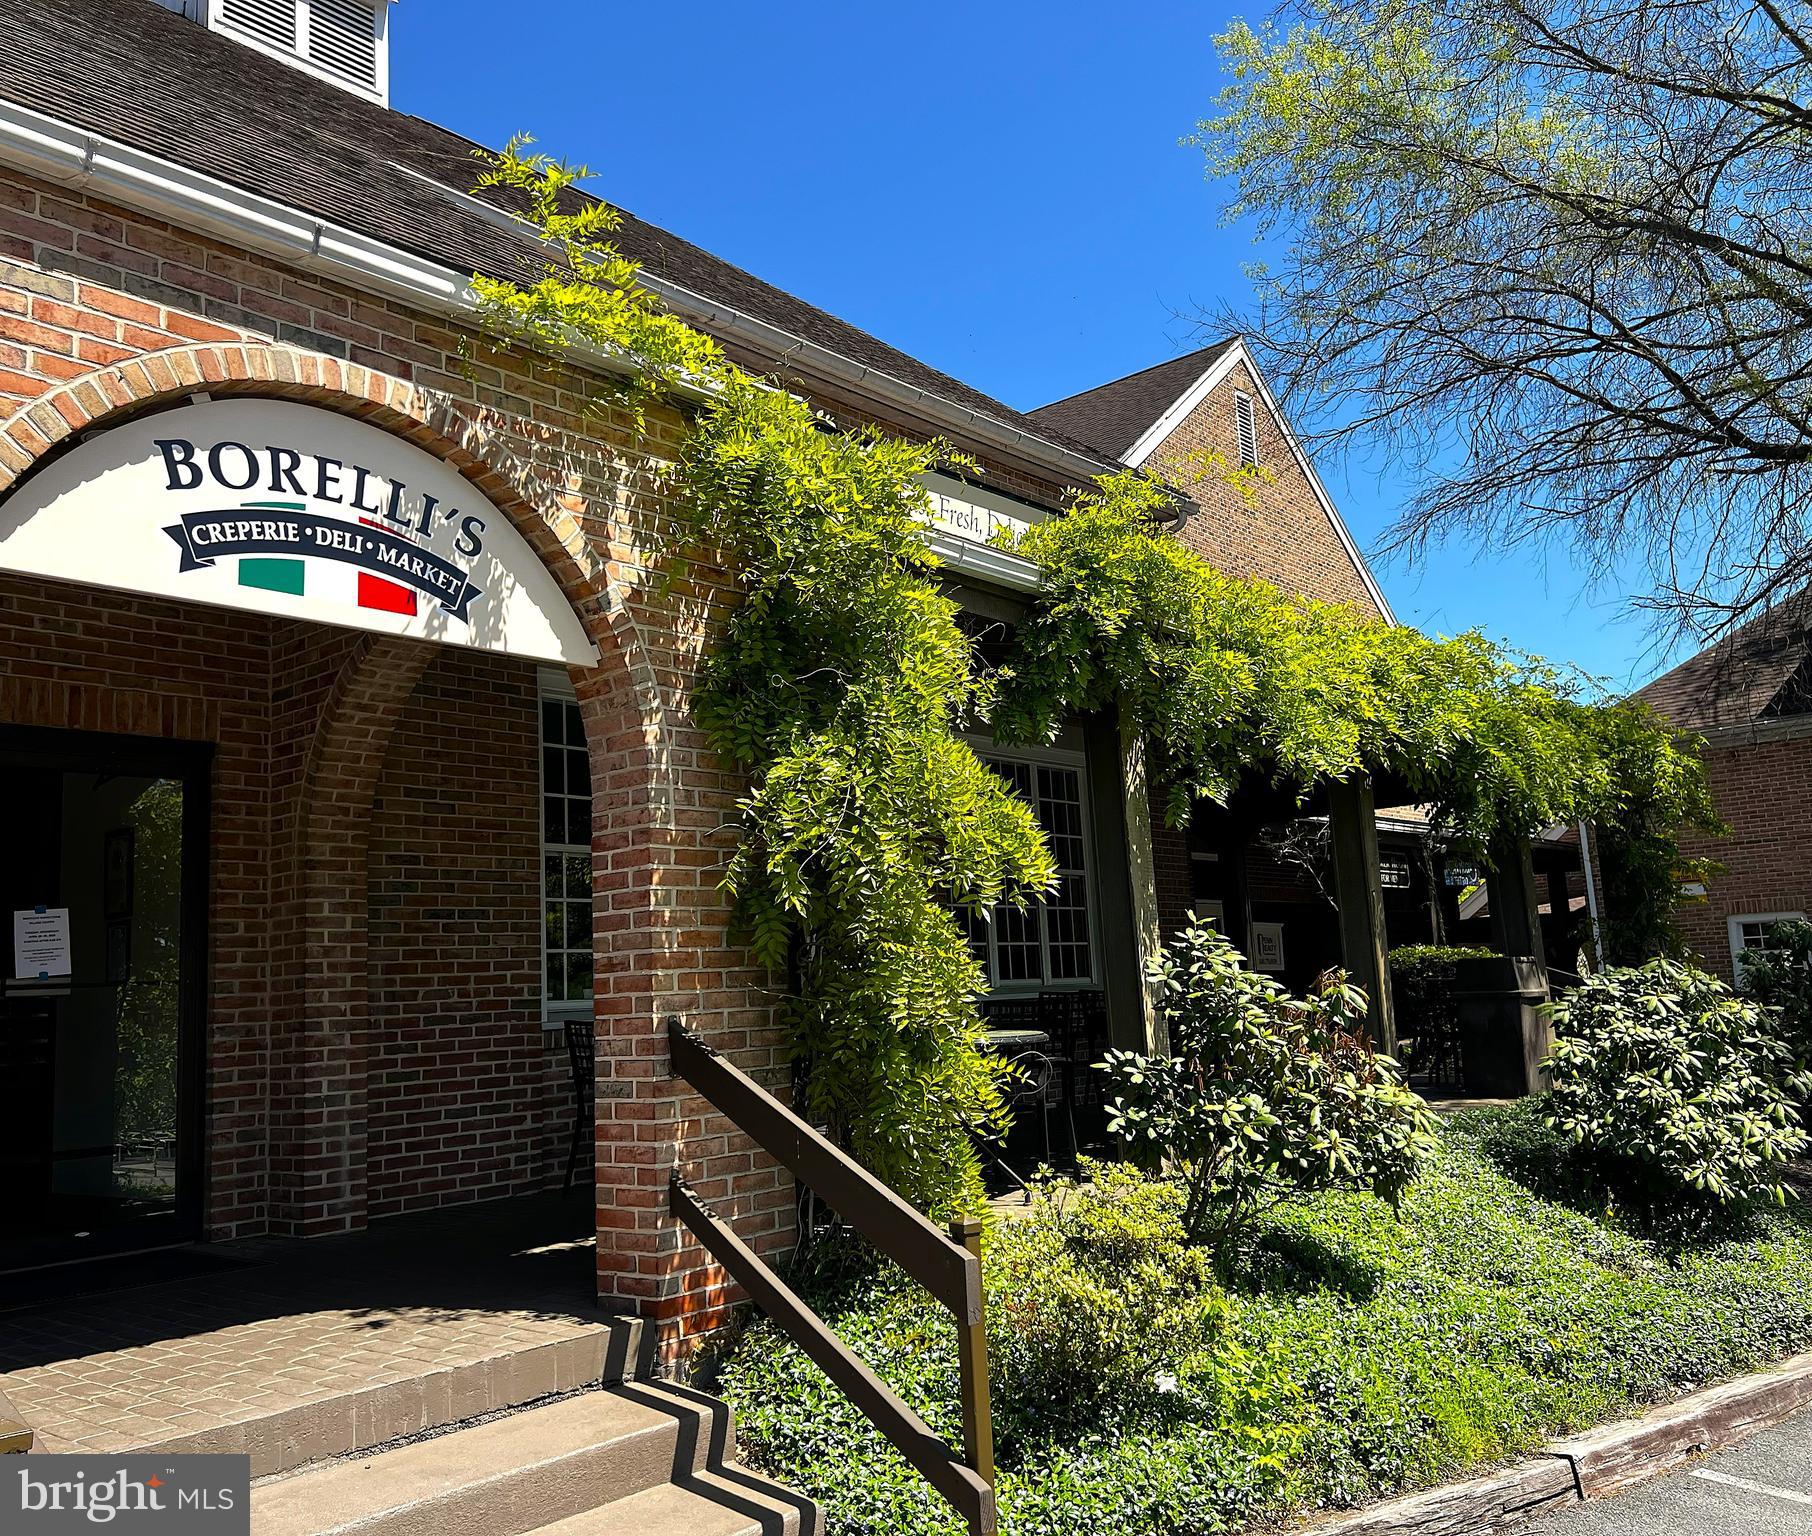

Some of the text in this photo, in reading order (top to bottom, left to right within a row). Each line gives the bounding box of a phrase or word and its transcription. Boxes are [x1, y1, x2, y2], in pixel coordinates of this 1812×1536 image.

[154, 439, 486, 557] BORELLI'S
[940, 494, 982, 538] Fresh,
[191, 520, 462, 595] CREPERIE DELI MARKET
